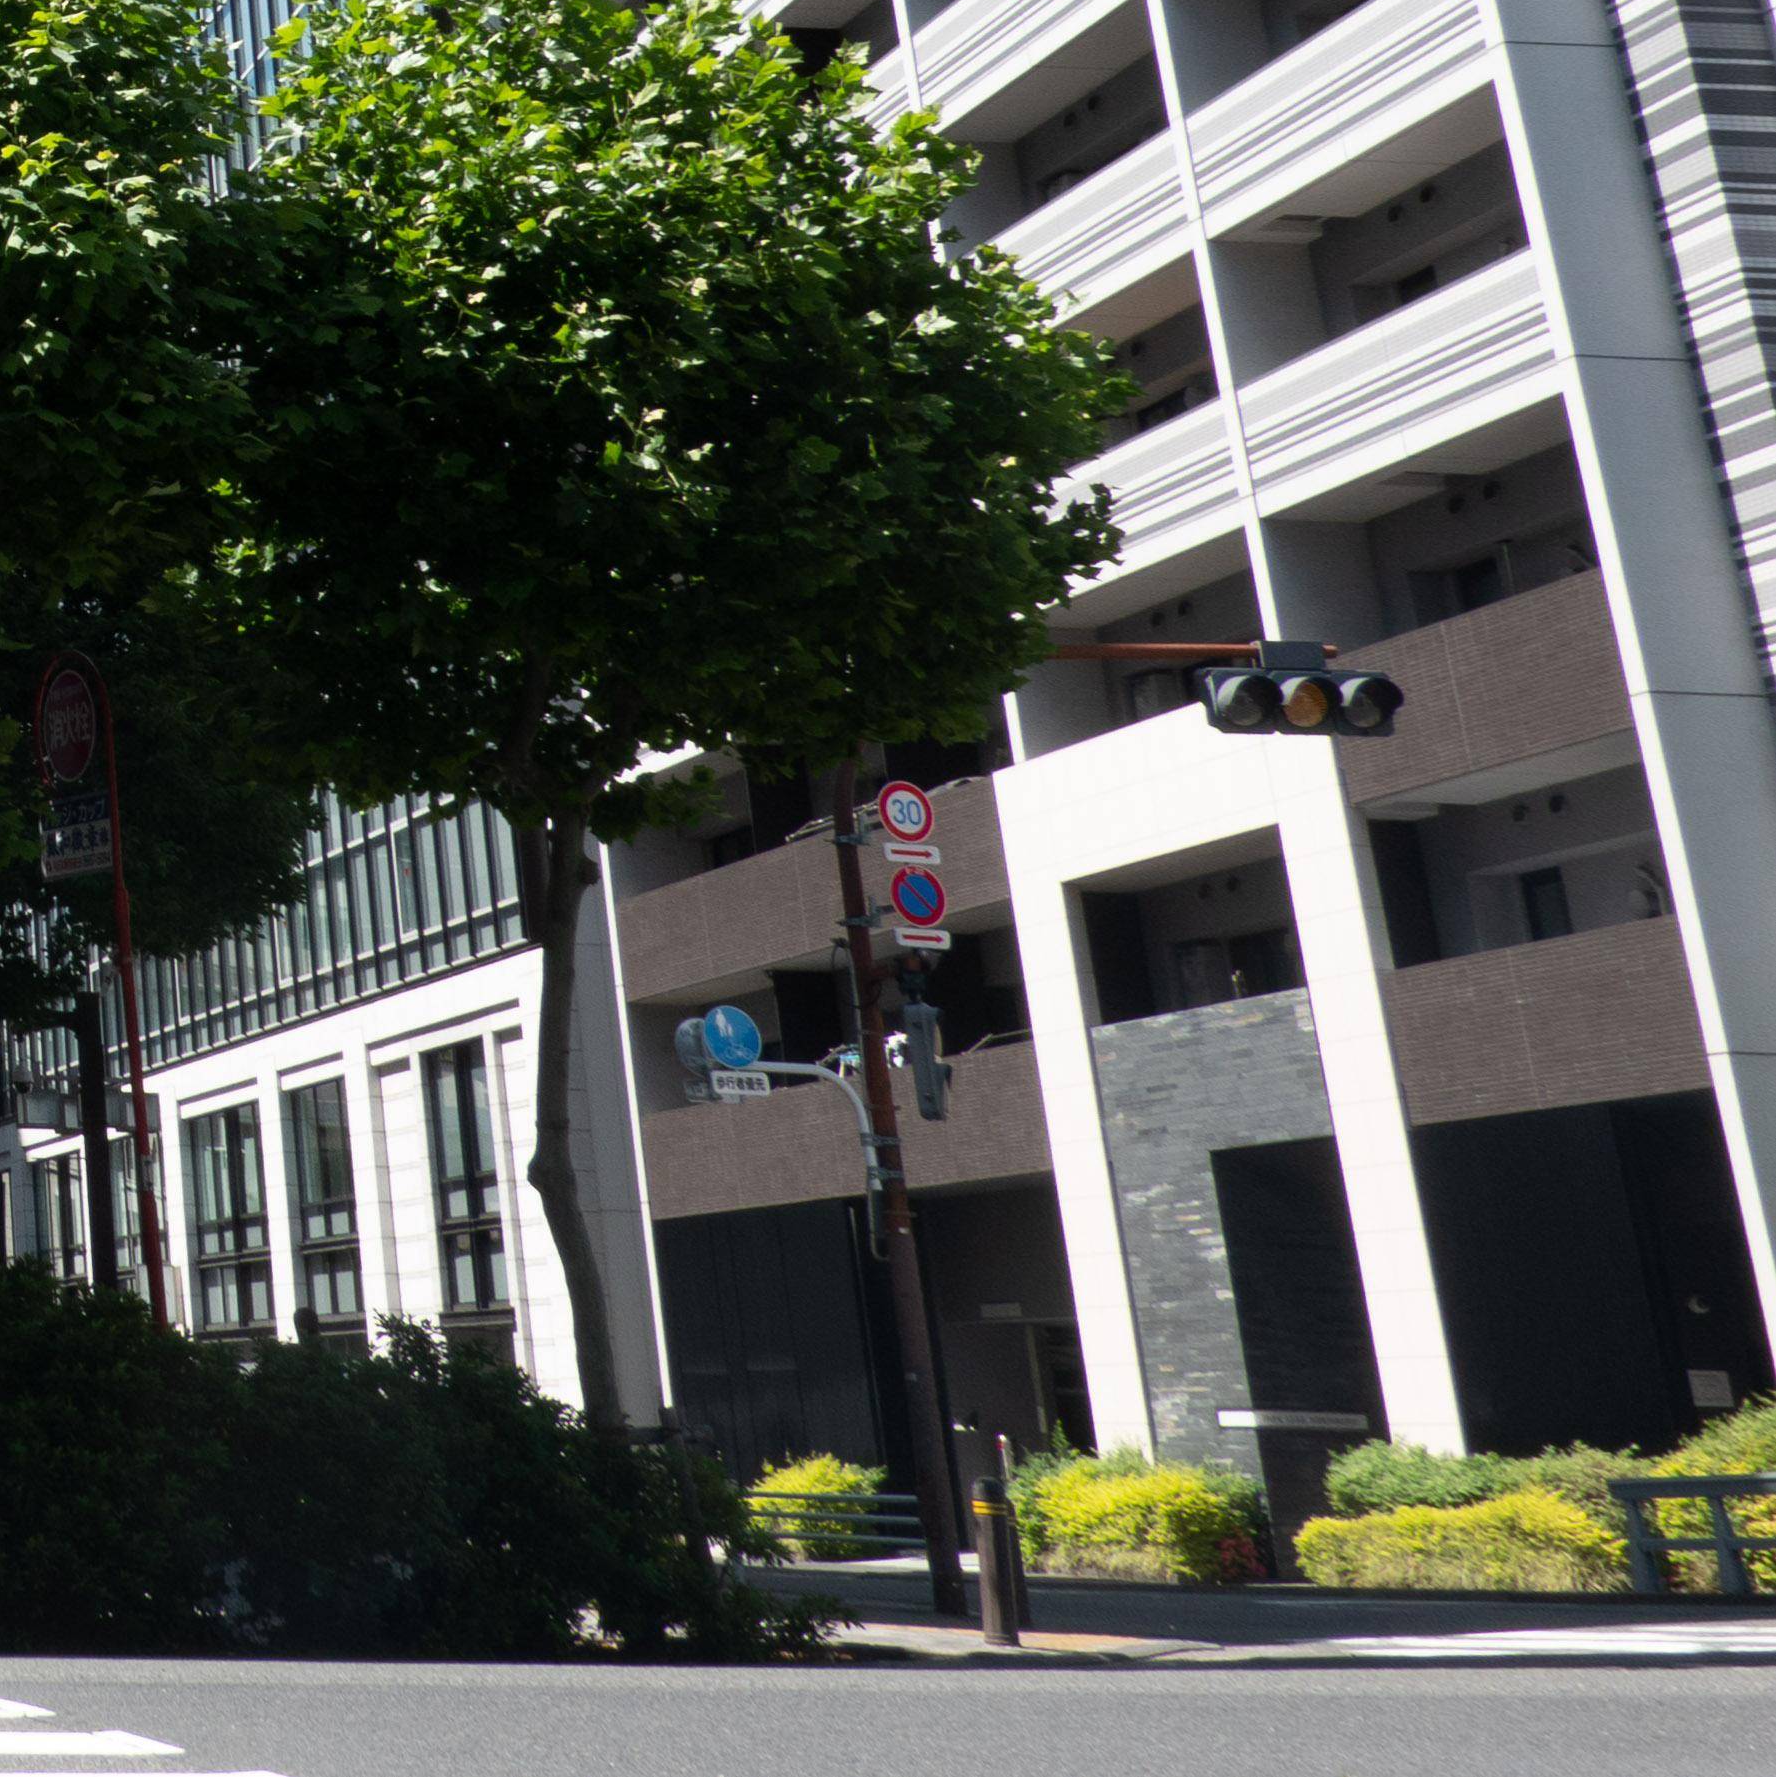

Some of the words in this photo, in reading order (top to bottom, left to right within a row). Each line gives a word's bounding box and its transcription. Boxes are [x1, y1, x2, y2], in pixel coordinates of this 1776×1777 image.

[891, 798, 923, 826] 30
[715, 1075, 767, 1092] 歩行者優先
